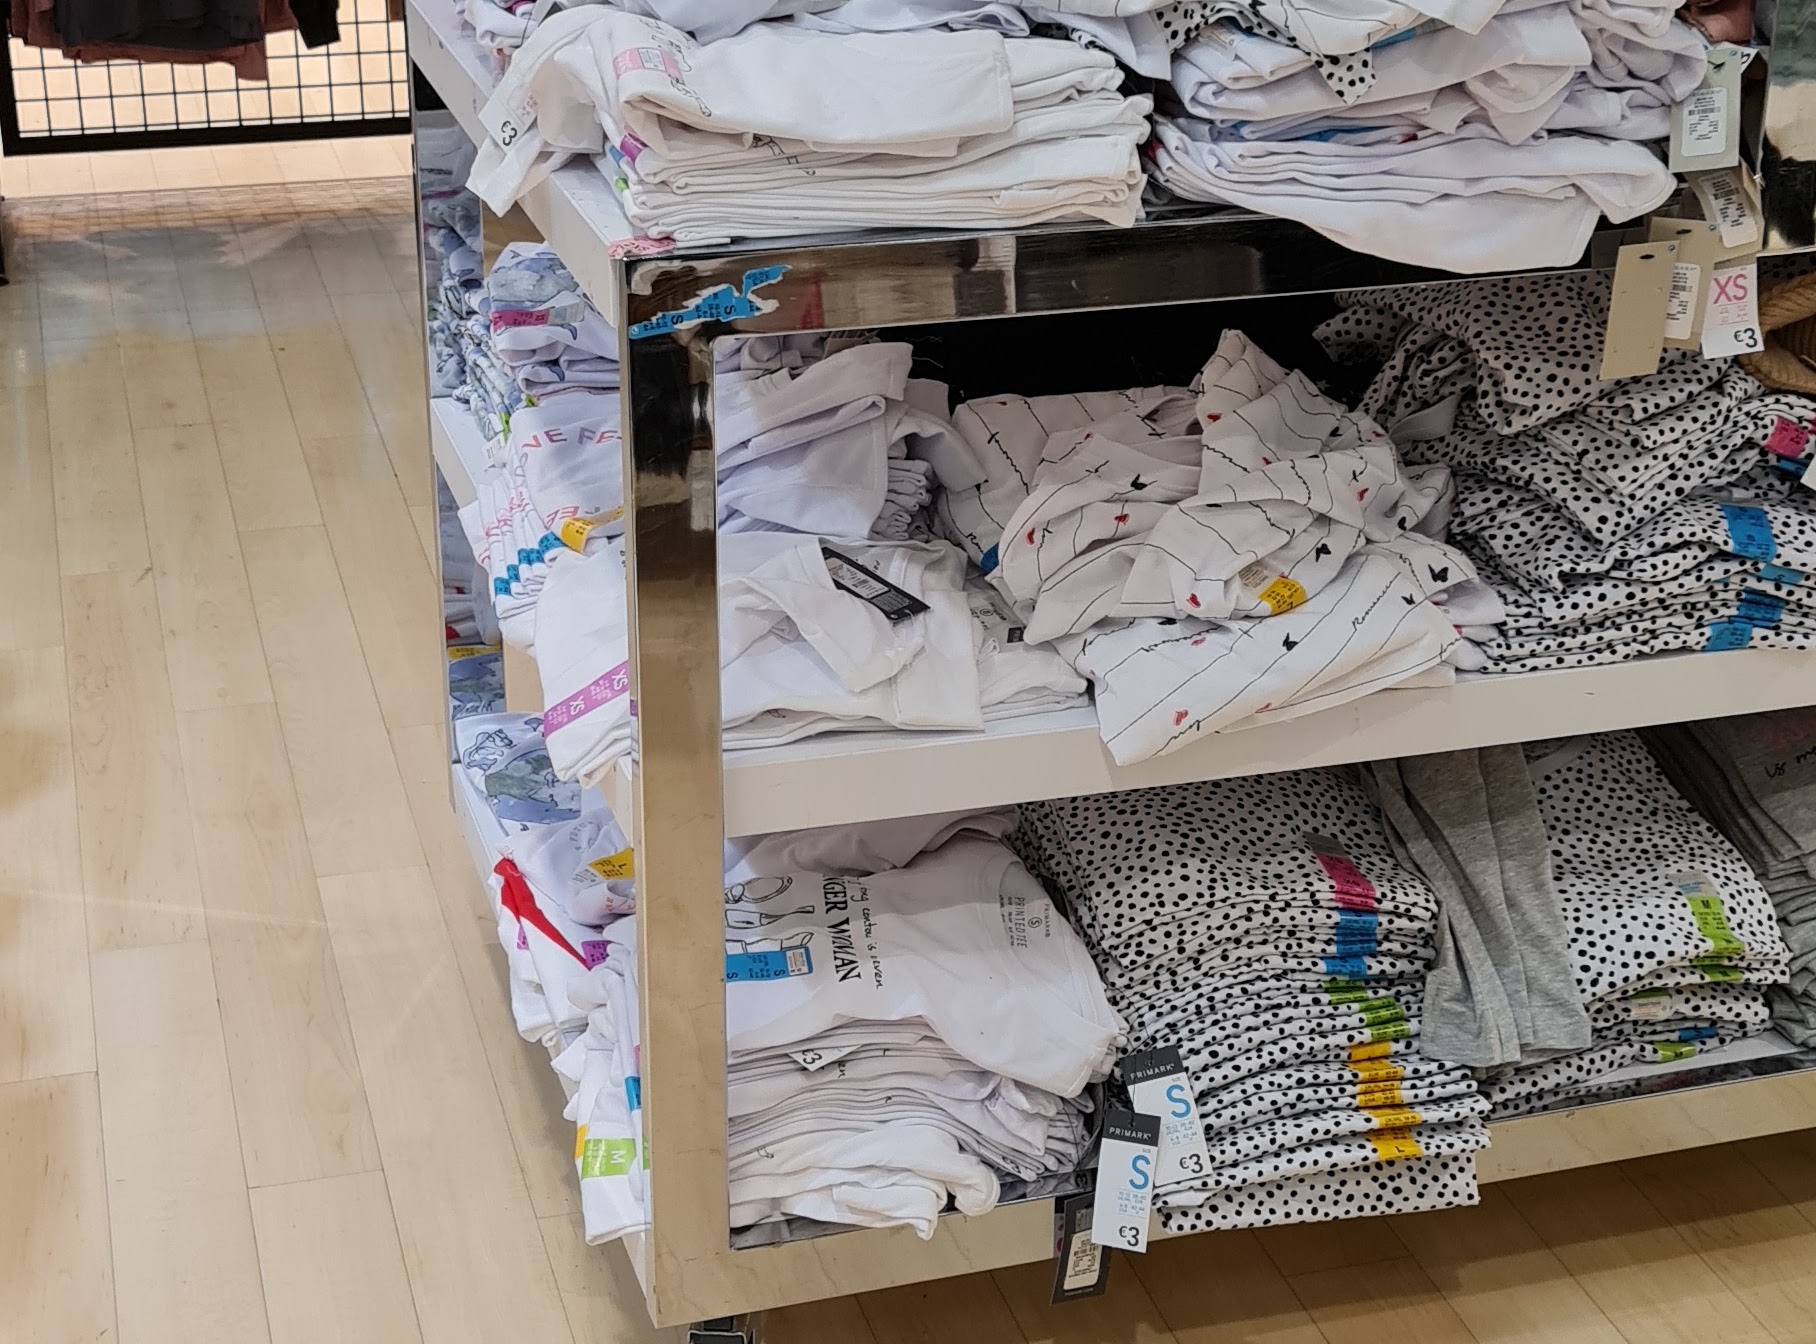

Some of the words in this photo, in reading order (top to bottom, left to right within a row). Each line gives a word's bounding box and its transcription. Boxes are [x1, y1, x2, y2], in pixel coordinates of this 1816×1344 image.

[501, 119, 518, 147] €3
[1713, 273, 1748, 304] XS
[671, 314, 684, 326] S
[724, 304, 737, 316] S
[1734, 327, 1758, 348] €3
[611, 669, 628, 691] XS
[569, 696, 586, 716] XS
[1015, 896, 1026, 934] PRINTED
[1016, 935, 1028, 948] TEE
[774, 968, 786, 977] S
[802, 1048, 823, 1065] €3
[1130, 1063, 1172, 1080] PRIMARK
[1166, 1084, 1191, 1118] S
[1109, 1126, 1149, 1140] PRIMARK
[610, 1150, 627, 1164] M
[1179, 1153, 1204, 1173] €3
[1129, 1154, 1151, 1190] S
[1119, 1226, 1140, 1247] €3
